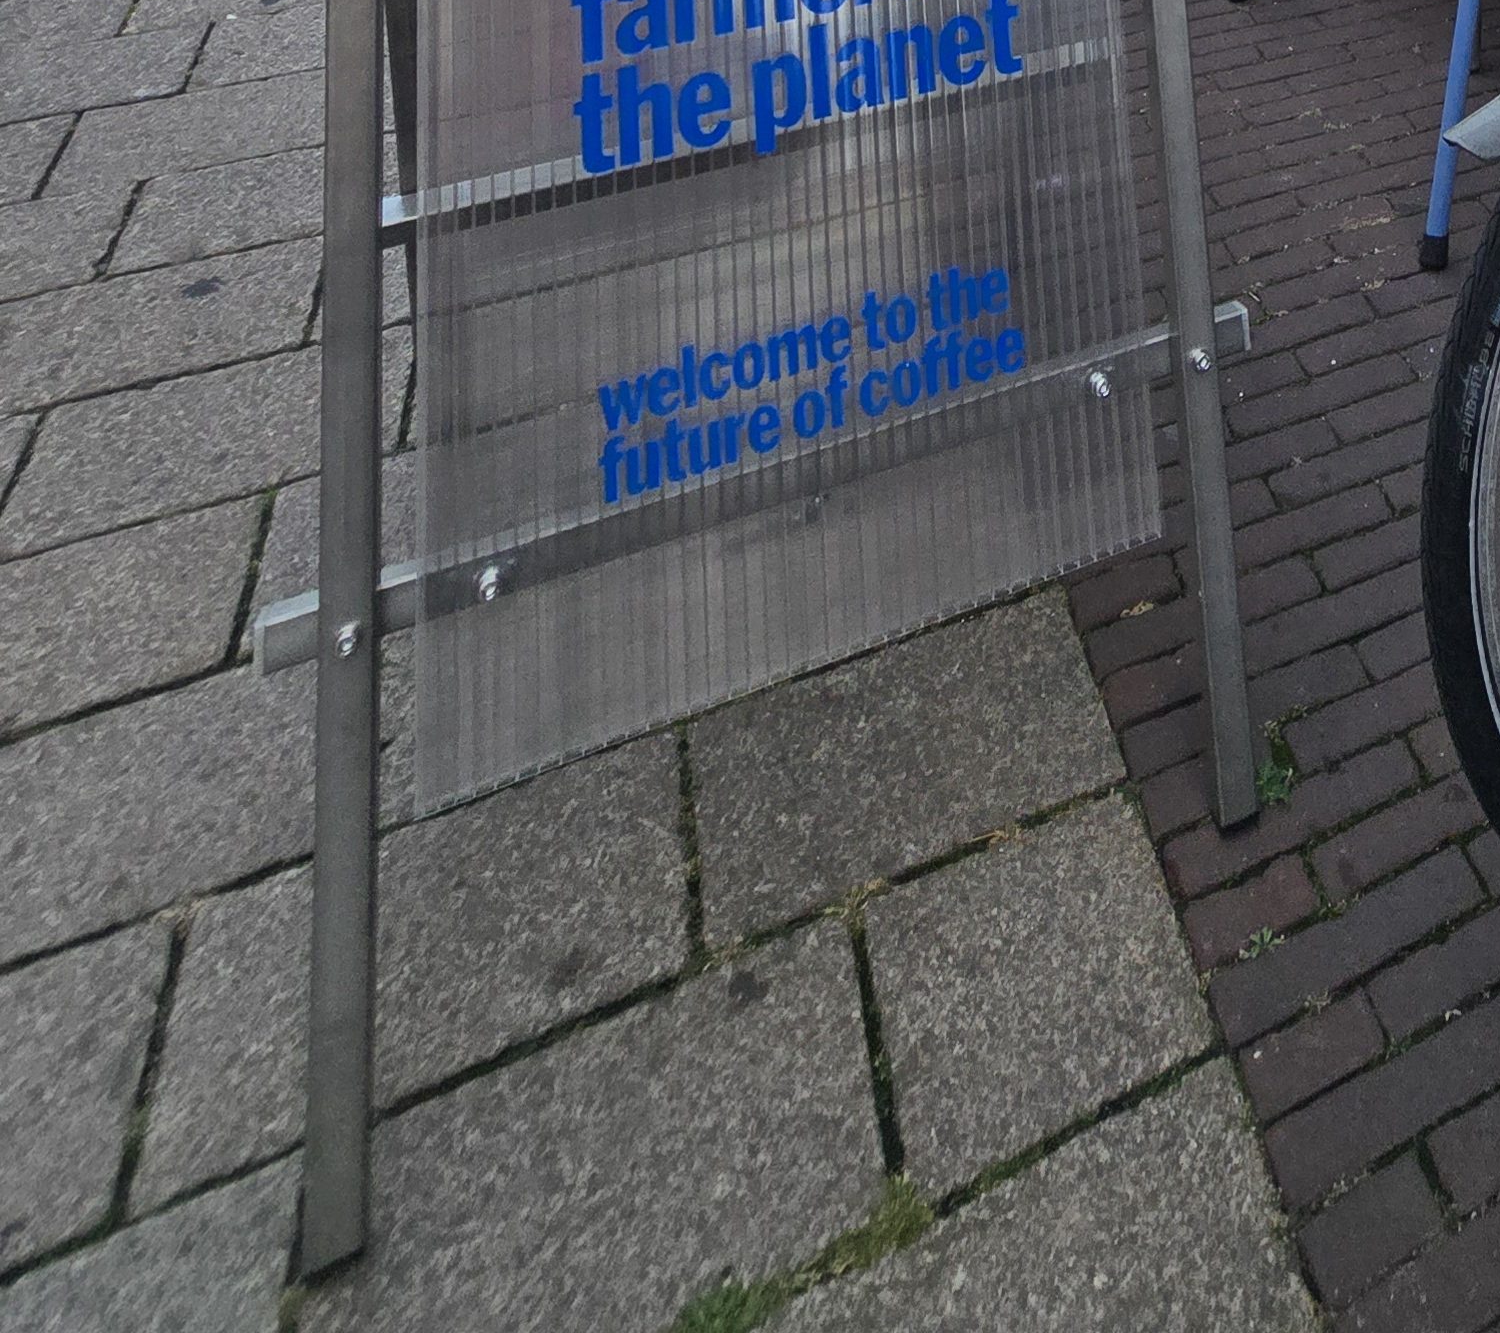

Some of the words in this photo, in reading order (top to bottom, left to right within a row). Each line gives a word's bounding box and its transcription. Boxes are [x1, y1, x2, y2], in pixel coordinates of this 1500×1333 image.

[572, 68, 731, 175] the
[600, 313, 852, 432] welcome
[861, 290, 916, 348] to
[927, 266, 1010, 327] the
[600, 408, 780, 503] future
[792, 373, 849, 439] of
[859, 323, 1026, 414] coffee
